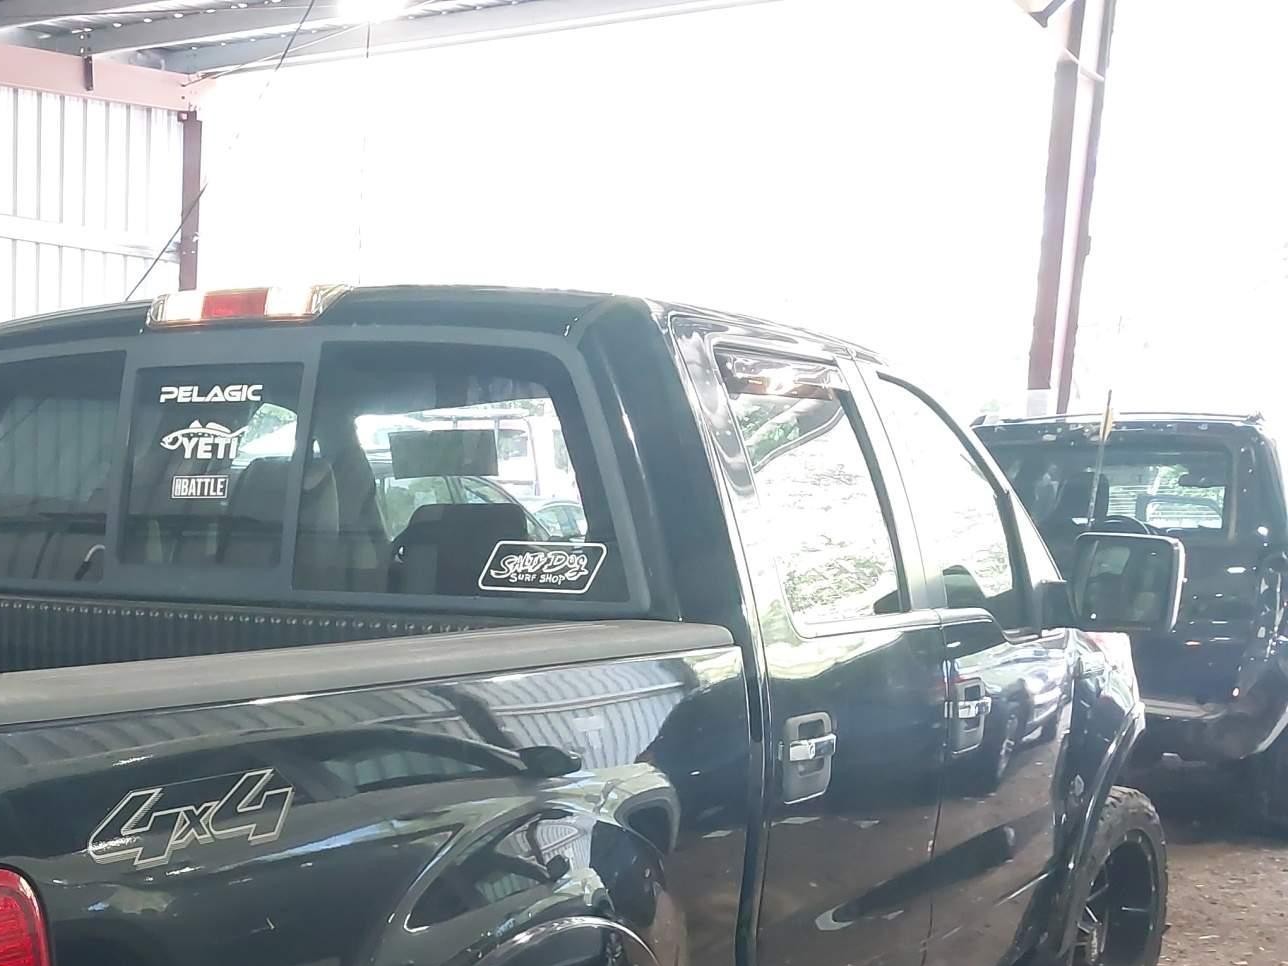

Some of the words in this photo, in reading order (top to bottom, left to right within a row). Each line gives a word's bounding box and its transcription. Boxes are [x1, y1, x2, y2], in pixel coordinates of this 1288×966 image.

[160, 385, 263, 403] PELAGIC
[182, 437, 238, 459] YETI
[509, 573, 537, 583] SURF
[539, 573, 565, 585] SHOP
[88, 767, 295, 870] 4x4
